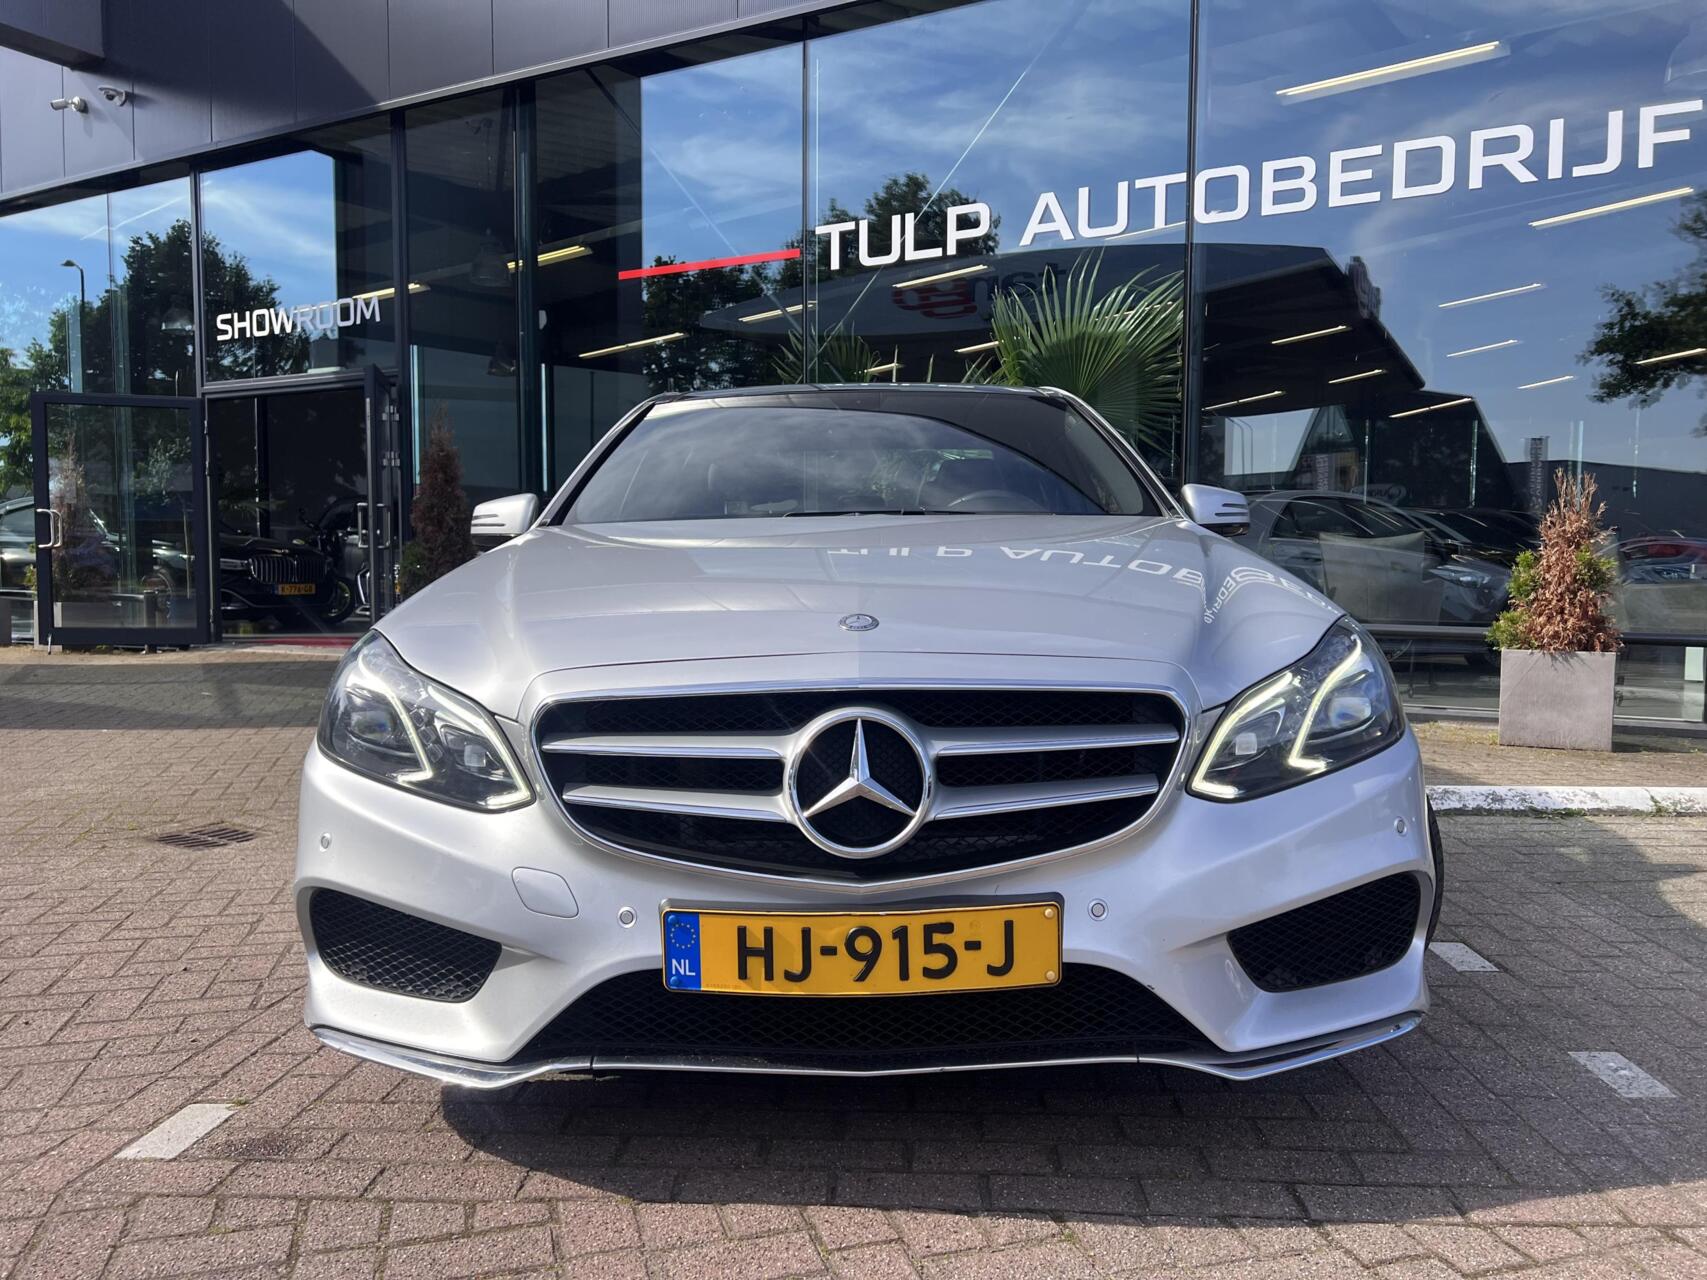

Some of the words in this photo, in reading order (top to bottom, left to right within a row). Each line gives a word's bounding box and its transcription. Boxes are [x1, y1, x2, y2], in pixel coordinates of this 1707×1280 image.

[815, 202, 991, 271] TULP
[1019, 99, 1703, 247] AUTOBEDRIJF
[216, 297, 381, 341] SHOWROOM
[671, 958, 696, 977] NL
[736, 919, 1015, 983] HJ-915-J
